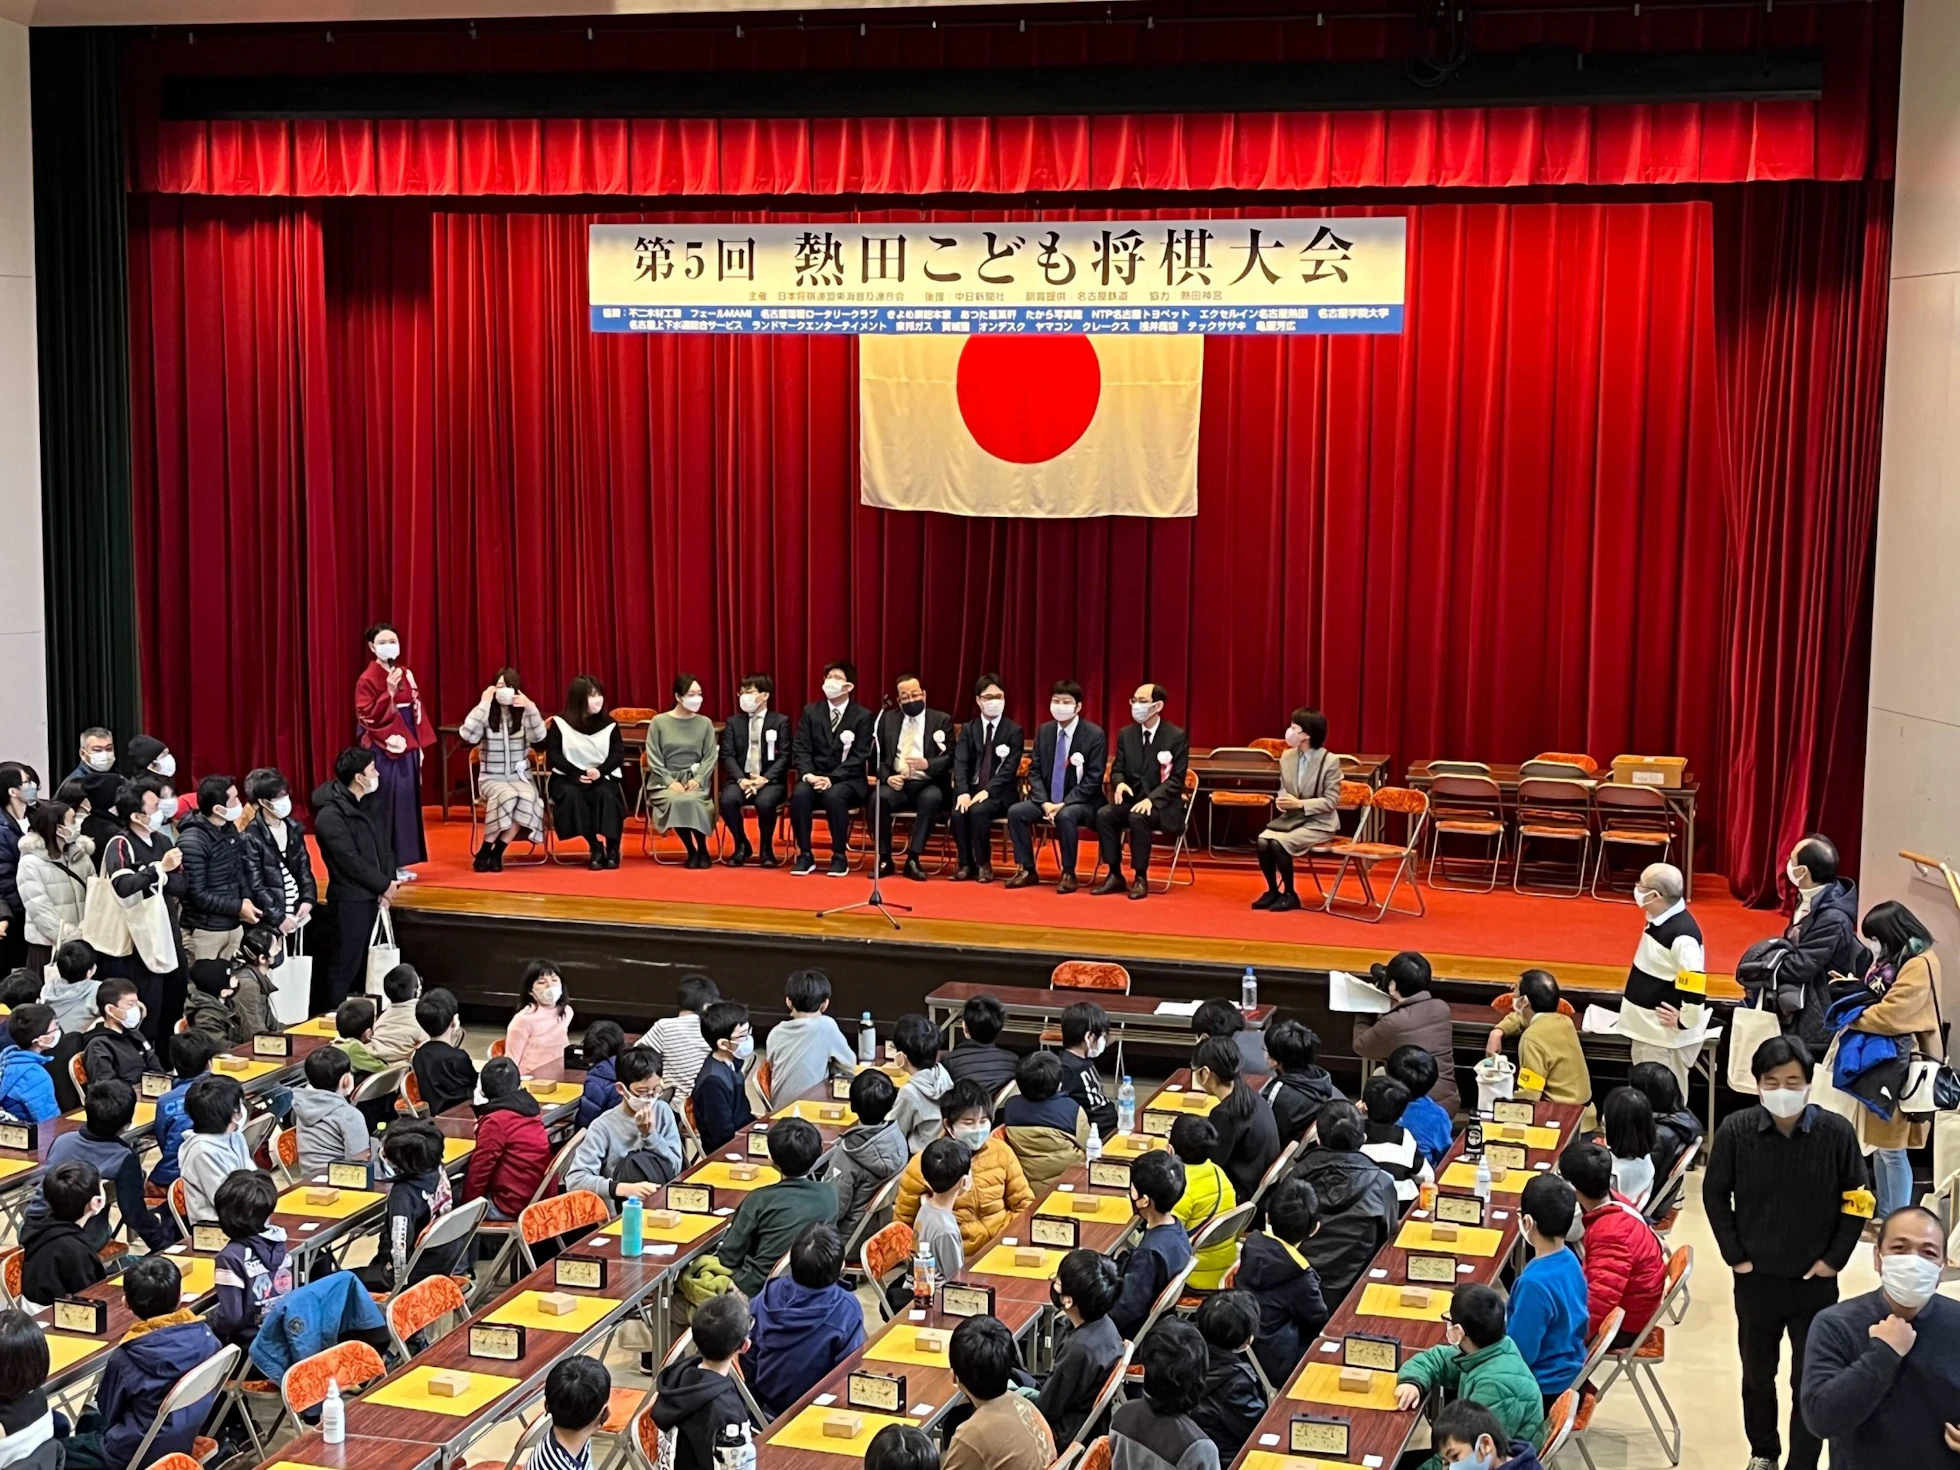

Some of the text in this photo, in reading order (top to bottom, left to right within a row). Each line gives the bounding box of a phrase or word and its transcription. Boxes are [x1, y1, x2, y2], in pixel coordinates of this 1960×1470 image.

[633, 225, 1354, 287] 第5回 熱田こども将棋大会
[760, 309, 878, 320] 名古ロータリークラブ
[960, 310, 1017, 320] あつた軒
